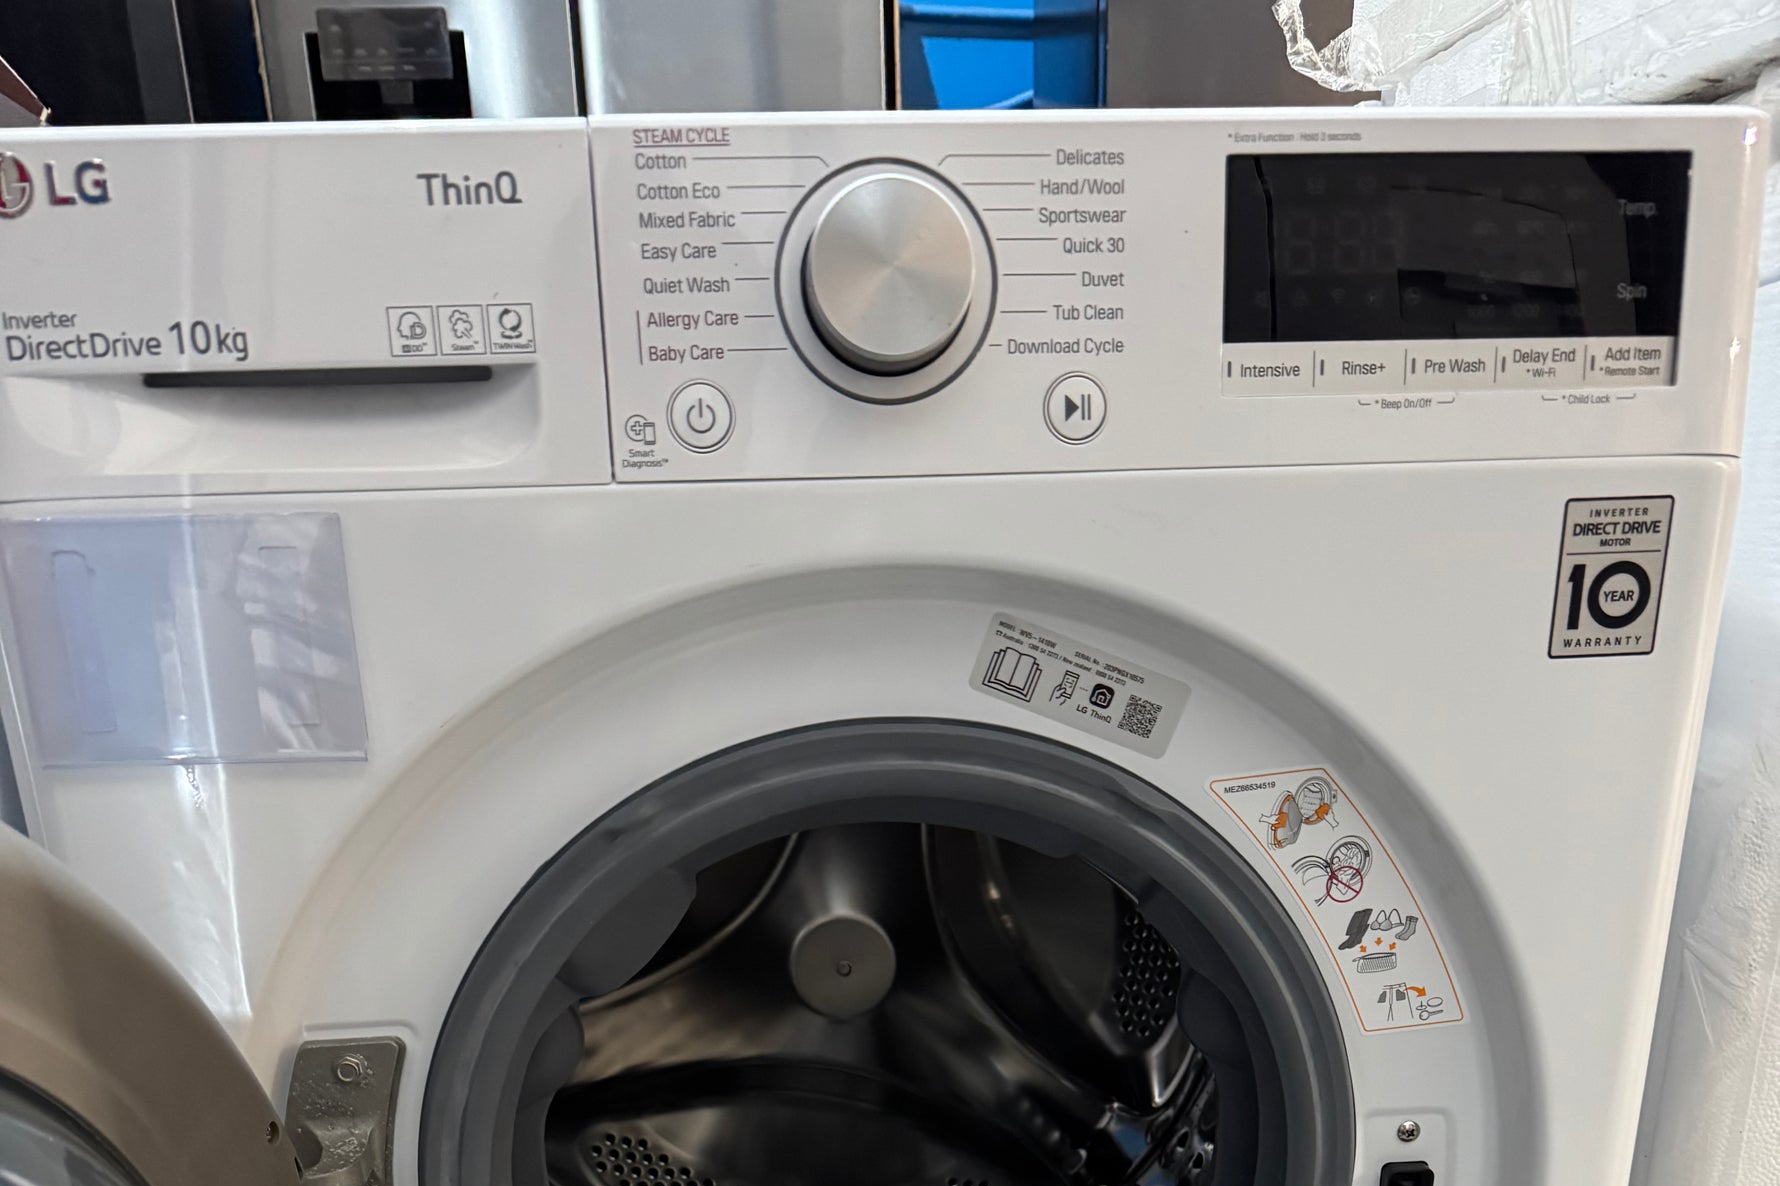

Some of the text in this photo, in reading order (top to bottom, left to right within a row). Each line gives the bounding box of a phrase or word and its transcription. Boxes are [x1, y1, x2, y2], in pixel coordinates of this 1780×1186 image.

[633, 128, 730, 144] STEAM CYCLE
[1258, 132, 1294, 142] Function
[634, 152, 687, 169] Cotton
[1056, 149, 1125, 166] Delicates
[44, 158, 111, 206] LG
[416, 170, 523, 206] ThinQ
[1040, 178, 1125, 196] Hand/Wool
[637, 182, 720, 200] Cotton Eco
[639, 211, 736, 228] Mixed Fabric
[1039, 207, 1127, 227] Sportswear
[641, 242, 716, 262] Easy Care
[1063, 237, 1125, 254] Quick 30
[643, 276, 730, 294] Quiet Wash
[1082, 271, 1125, 287] Duvet
[1, 311, 77, 330] Inverter
[647, 310, 739, 330] Allergy Care
[1053, 304, 1124, 320] Tub Clean
[649, 344, 725, 364] Baby Care
[1007, 337, 1125, 356] Download Cycle
[1605, 347, 1661, 361] Add Item
[1513, 348, 1576, 365] Delay End
[1240, 363, 1300, 378] Intensive
[1342, 360, 1386, 376] Rinse+
[1424, 358, 1486, 374] Pre Wash
[1605, 366, 1660, 377] Remote Start
[1381, 398, 1432, 410] Beep On/Off
[1568, 394, 1611, 404] Child Lock
[629, 449, 655, 458] Smart
[1589, 507, 1649, 518] INVERTER
[1572, 520, 1662, 537] DIRECT DRIVE
[1599, 538, 1631, 547] MOTOR
[1567, 560, 1651, 630] 10
[1603, 590, 1634, 603] YEAR
[1563, 636, 1642, 648] WARRANTY
[1076, 704, 1112, 724] LG ThinQ
